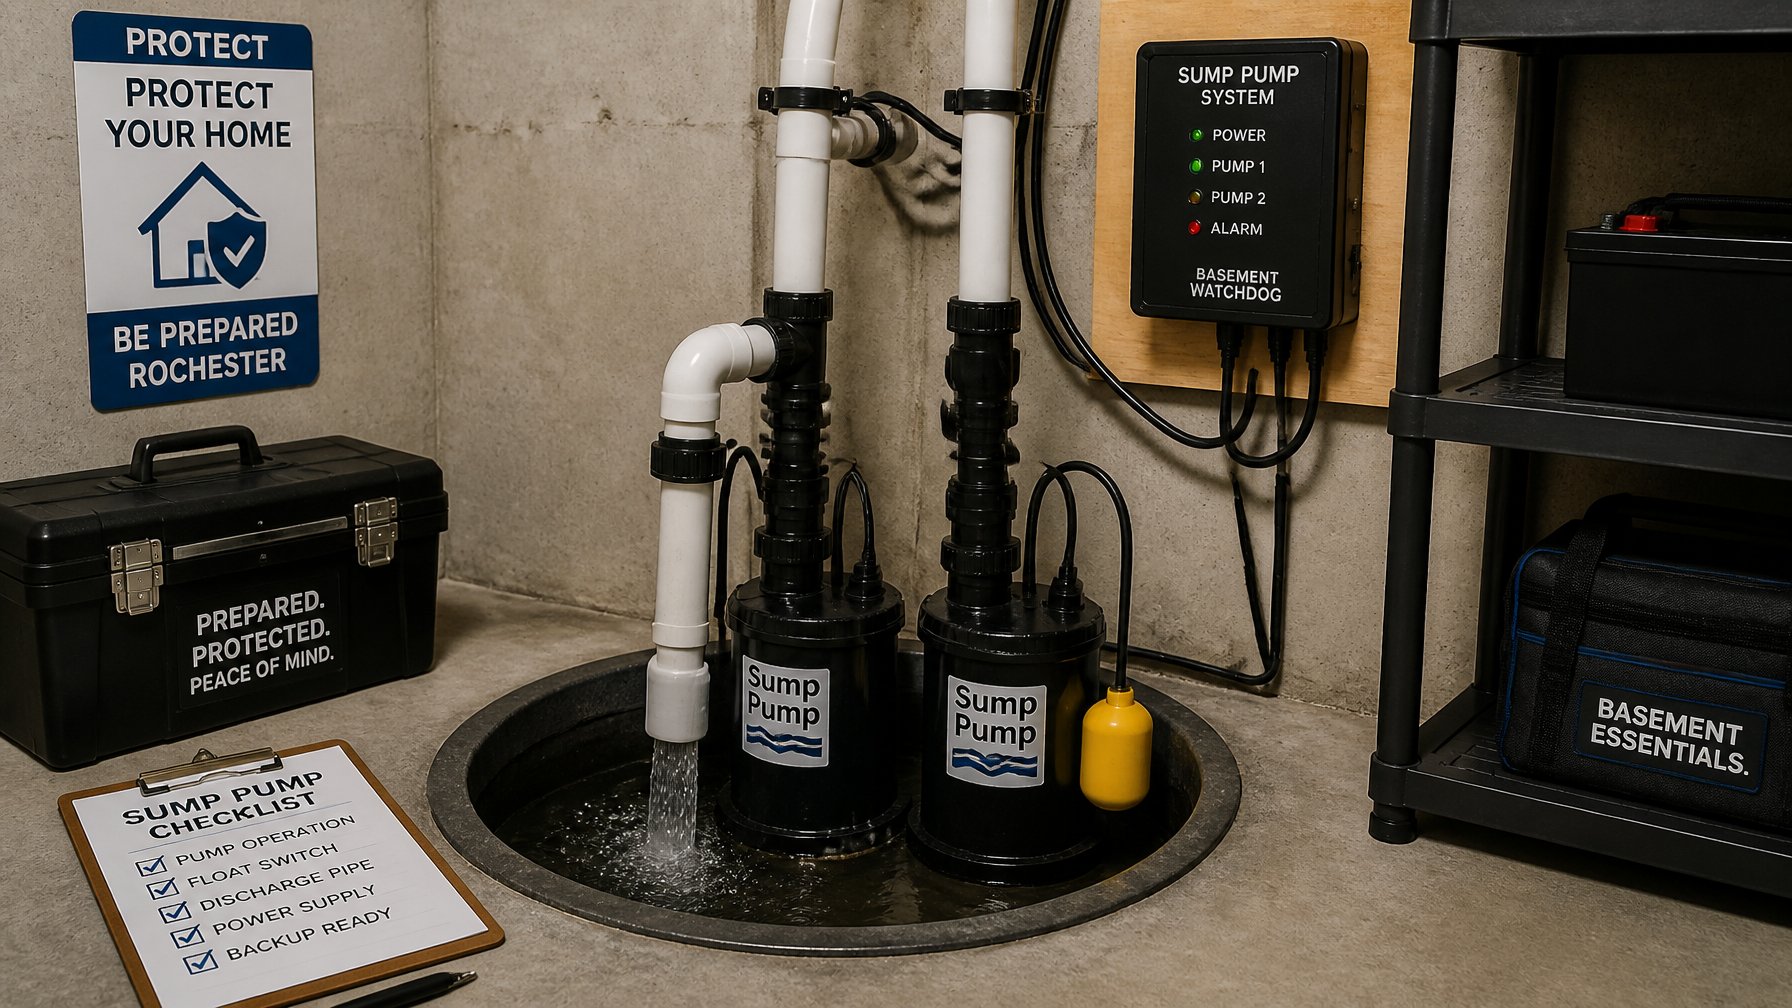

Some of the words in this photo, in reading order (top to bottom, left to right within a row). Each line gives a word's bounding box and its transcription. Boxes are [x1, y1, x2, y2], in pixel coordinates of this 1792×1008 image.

[126, 27, 269, 60] PROTECT
[126, 77, 274, 109] PROTECT
[1178, 66, 1233, 84] SUMP
[1241, 65, 1300, 83] PUMP
[1201, 89, 1274, 105] SYSTEM
[105, 119, 196, 148] YOUR
[205, 120, 292, 148] HOME
[1213, 128, 1266, 142] POWER
[1212, 160, 1254, 173] PUMP
[1259, 160, 1265, 174] 1
[1211, 191, 1253, 204] PUMP
[1257, 192, 1266, 205] 2
[1210, 222, 1263, 236] ALARM
[1190, 282, 1282, 302] WATCHDOG
[1196, 267, 1279, 284] BASEMENT
[113, 324, 150, 353] BE
[160, 311, 298, 348] PREPARED
[129, 348, 286, 389] ROCHESTER
[196, 590, 325, 636] PREPARED.
[192, 618, 331, 668] PROTECTED.
[190, 664, 251, 695] PEACE
[255, 656, 280, 679] OF
[285, 645, 335, 672] MIND.
[748, 664, 821, 703] Sump
[748, 691, 821, 729] Pump
[955, 684, 1038, 722] Sump
[1597, 697, 1743, 746] BASEMENT
[955, 713, 1037, 751] Pump
[1590, 722, 1749, 776] ESSENTIALS.
[122, 793, 221, 826] SUMP
[231, 771, 324, 803] PUMP
[149, 791, 316, 840] CHECKLIST
[175, 843, 235, 866] PUMP
[242, 815, 356, 851] OPERATION
[187, 863, 252, 888] FLOAT
[258, 843, 338, 871] SWITCH
[200, 872, 324, 912] DISCHARGE
[328, 858, 375, 882] PIPE
[212, 907, 294, 936] POWER
[298, 884, 377, 913] SUPPLY
[226, 928, 315, 962] BACKUP
[323, 907, 393, 936] READY
